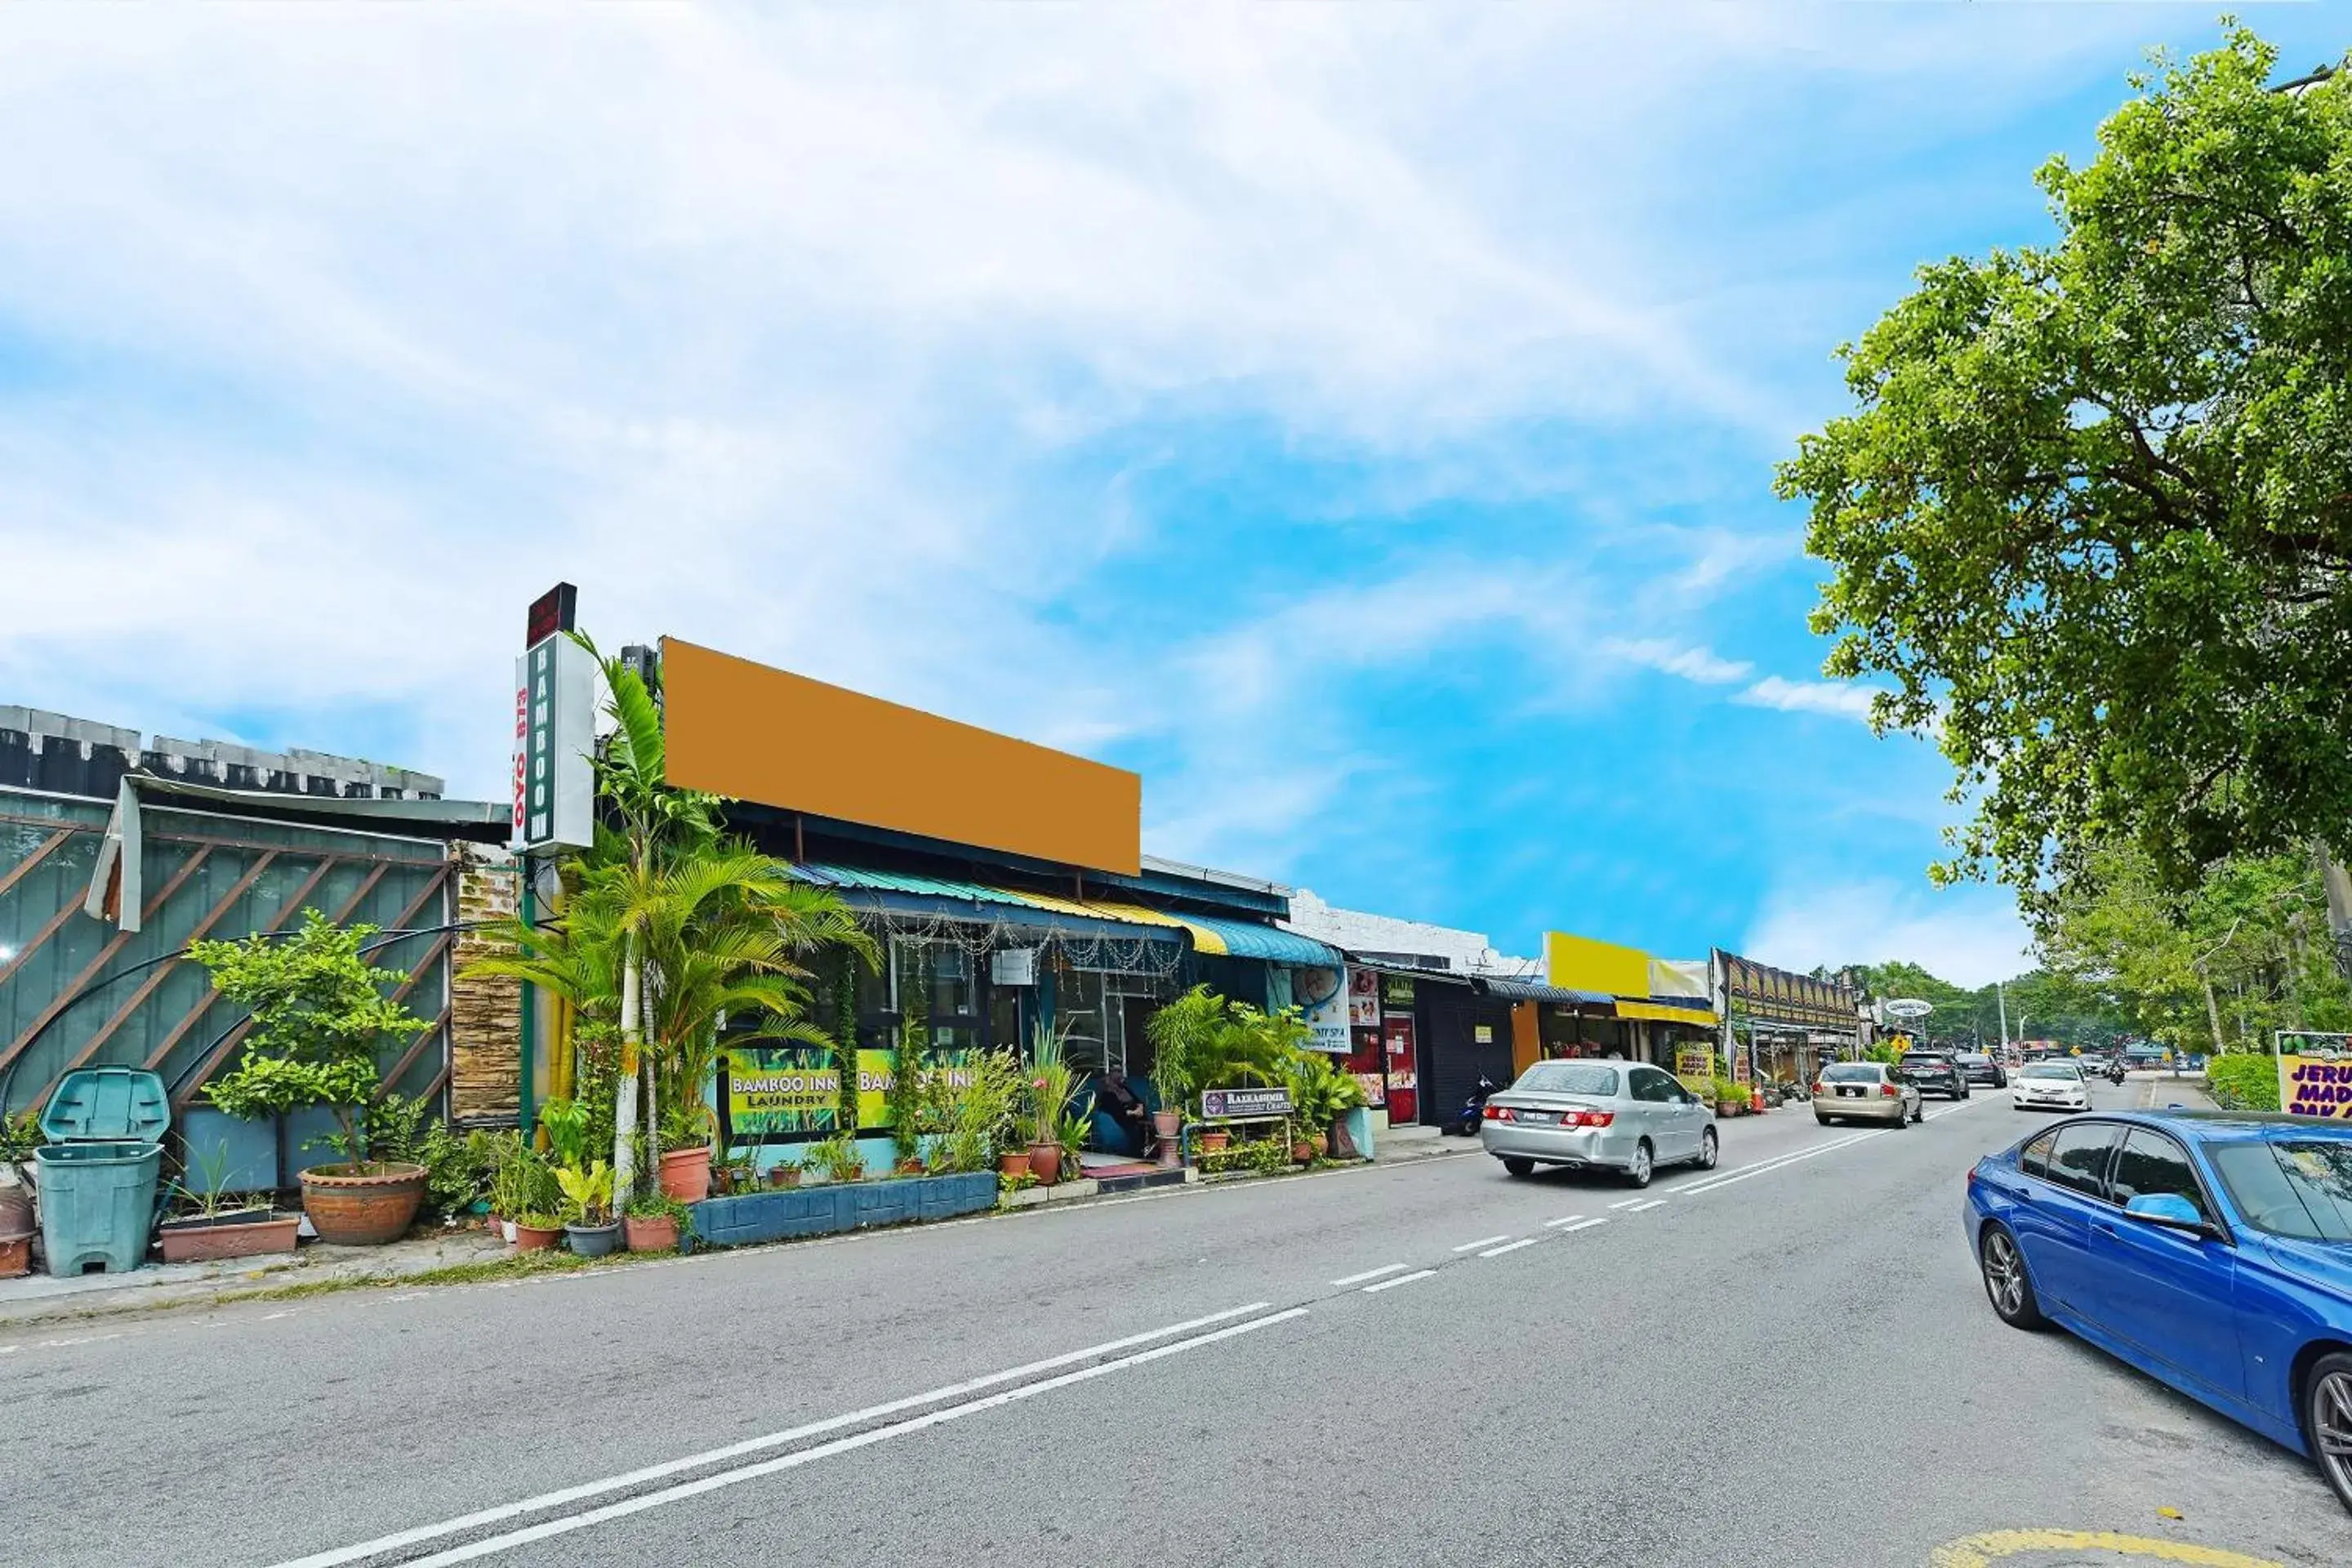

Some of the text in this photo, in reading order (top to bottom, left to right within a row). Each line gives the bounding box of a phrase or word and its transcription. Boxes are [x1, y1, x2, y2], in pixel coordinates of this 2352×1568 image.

[534, 648, 548, 808] BAMBOO
[515, 752, 525, 827] OYO
[733, 1076, 838, 1093] BAMBOO INN
[746, 1095, 826, 1108] LAUNDRY
